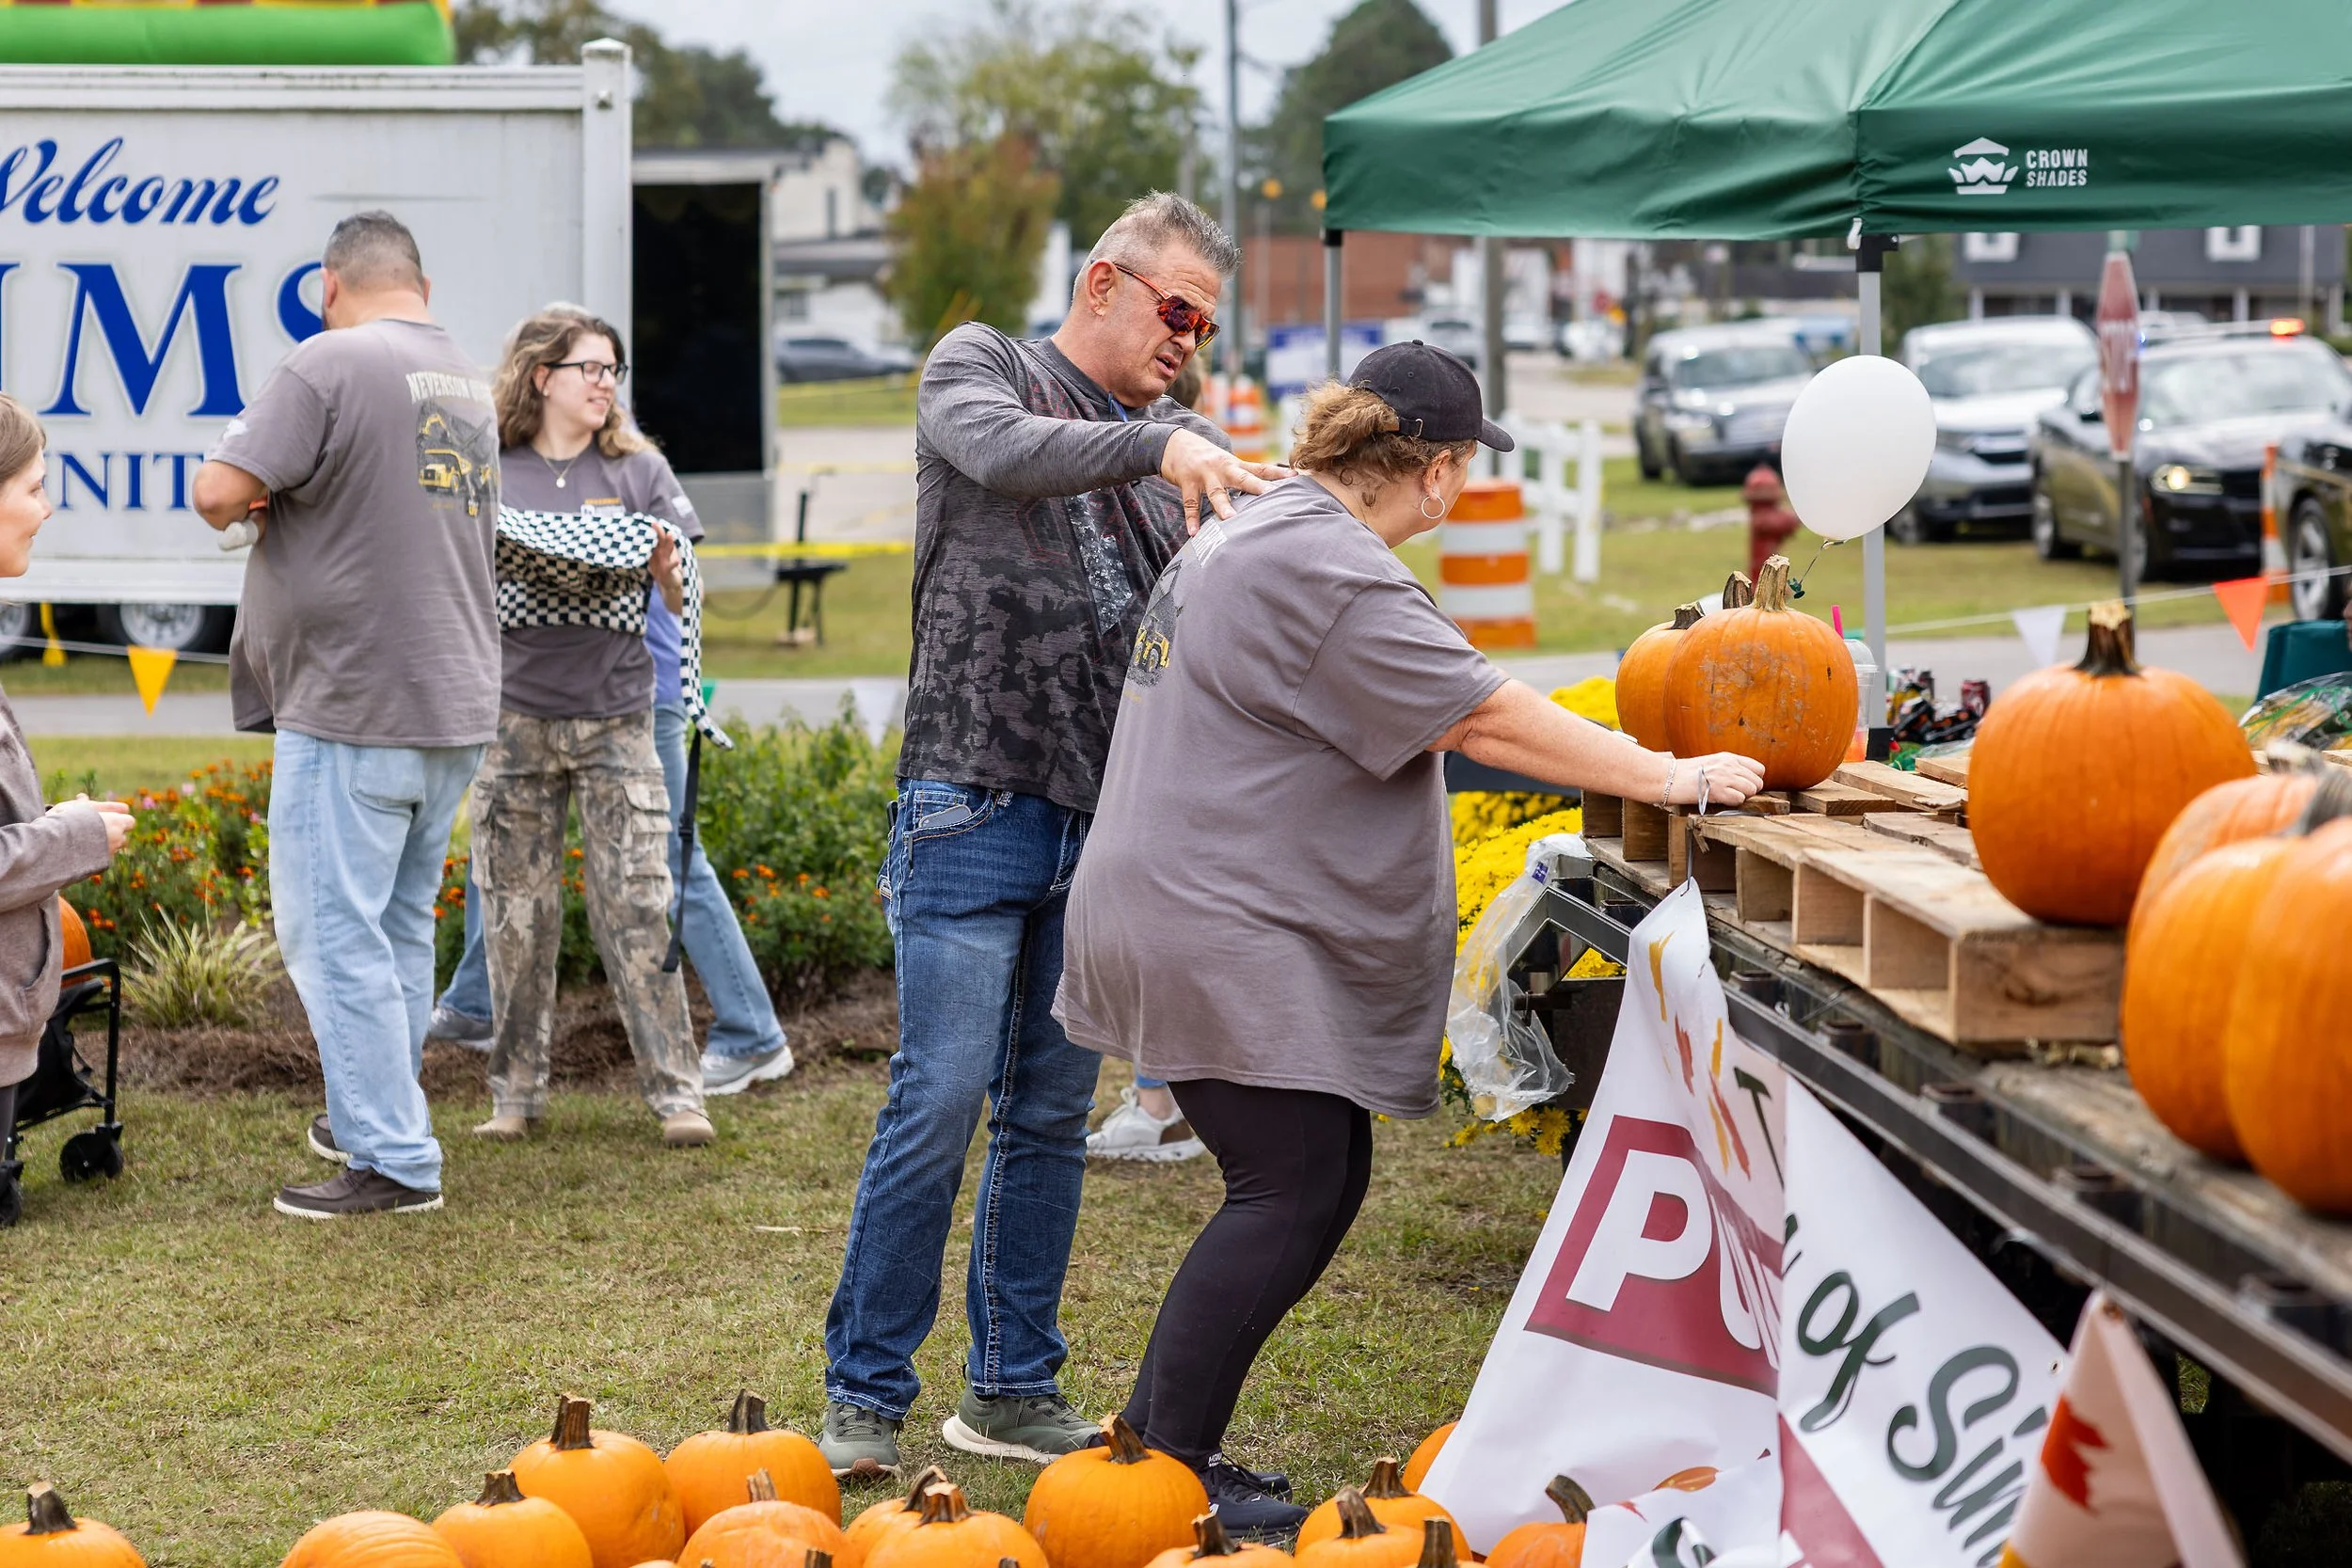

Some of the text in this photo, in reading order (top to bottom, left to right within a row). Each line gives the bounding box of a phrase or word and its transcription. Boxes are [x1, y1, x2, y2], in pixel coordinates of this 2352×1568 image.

[2026, 149, 2089, 168] CROWN
[2026, 169, 2088, 187] SHADES
[43, 451, 205, 511] NIT
[1798, 1271, 1920, 1432] of
